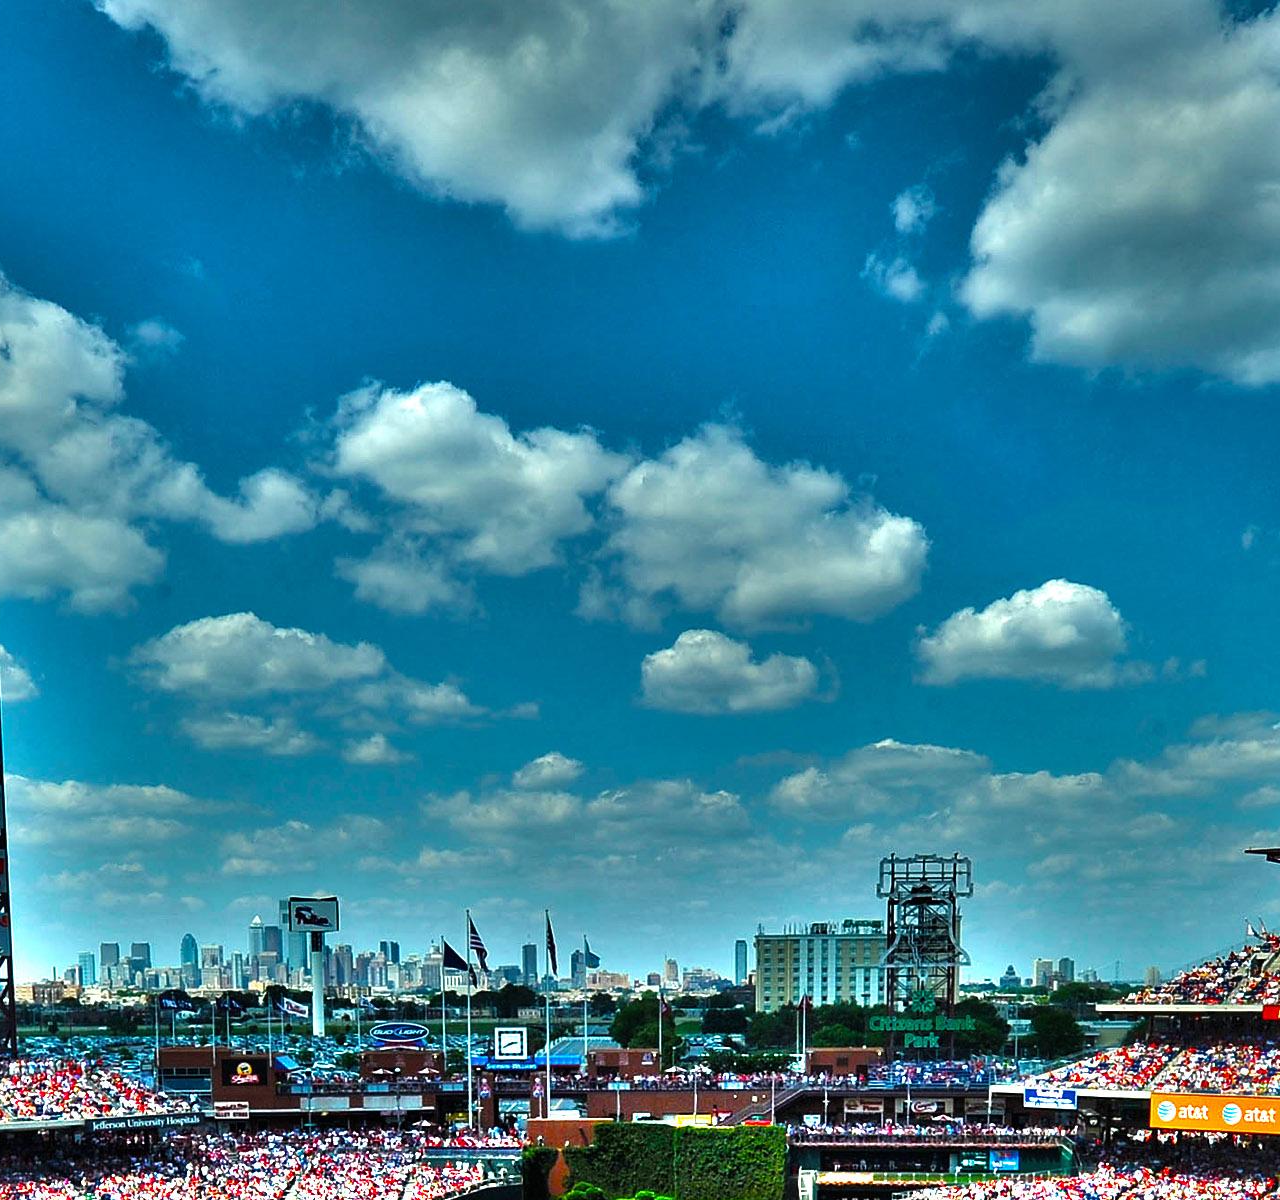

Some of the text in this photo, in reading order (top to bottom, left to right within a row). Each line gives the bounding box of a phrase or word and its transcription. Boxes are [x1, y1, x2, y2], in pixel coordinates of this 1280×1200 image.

[869, 1014, 977, 1031] Citizens Bank
[398, 1028, 426, 1036] LIGHT
[904, 1031, 941, 1049] Park
[1178, 1103, 1209, 1121] at&t
[1243, 1106, 1277, 1124] at&t
[92, 1114, 200, 1131] Jefferson University Hospitals
